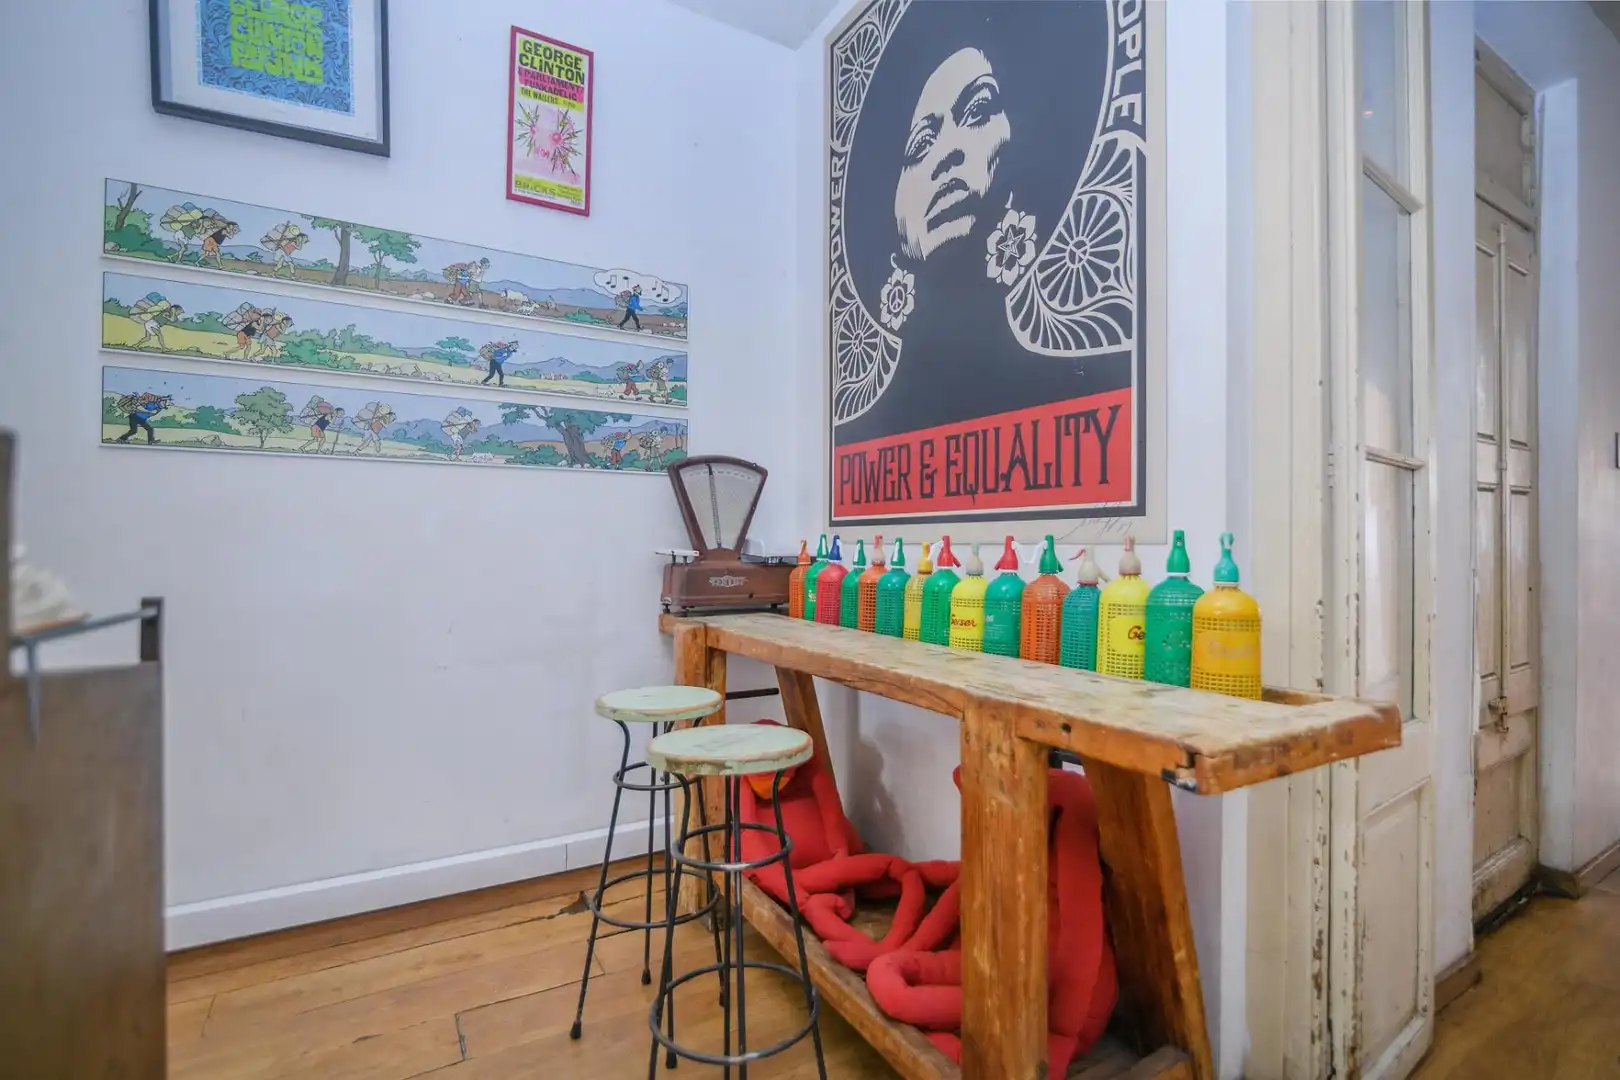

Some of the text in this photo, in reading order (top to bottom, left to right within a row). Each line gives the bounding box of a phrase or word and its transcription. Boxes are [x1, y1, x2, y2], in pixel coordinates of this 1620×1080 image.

[518, 53, 585, 86] CLINTON
[522, 39, 583, 72] GEORGE
[830, 155, 846, 290] POWER
[839, 404, 1123, 506] POWER & EQUALITY
